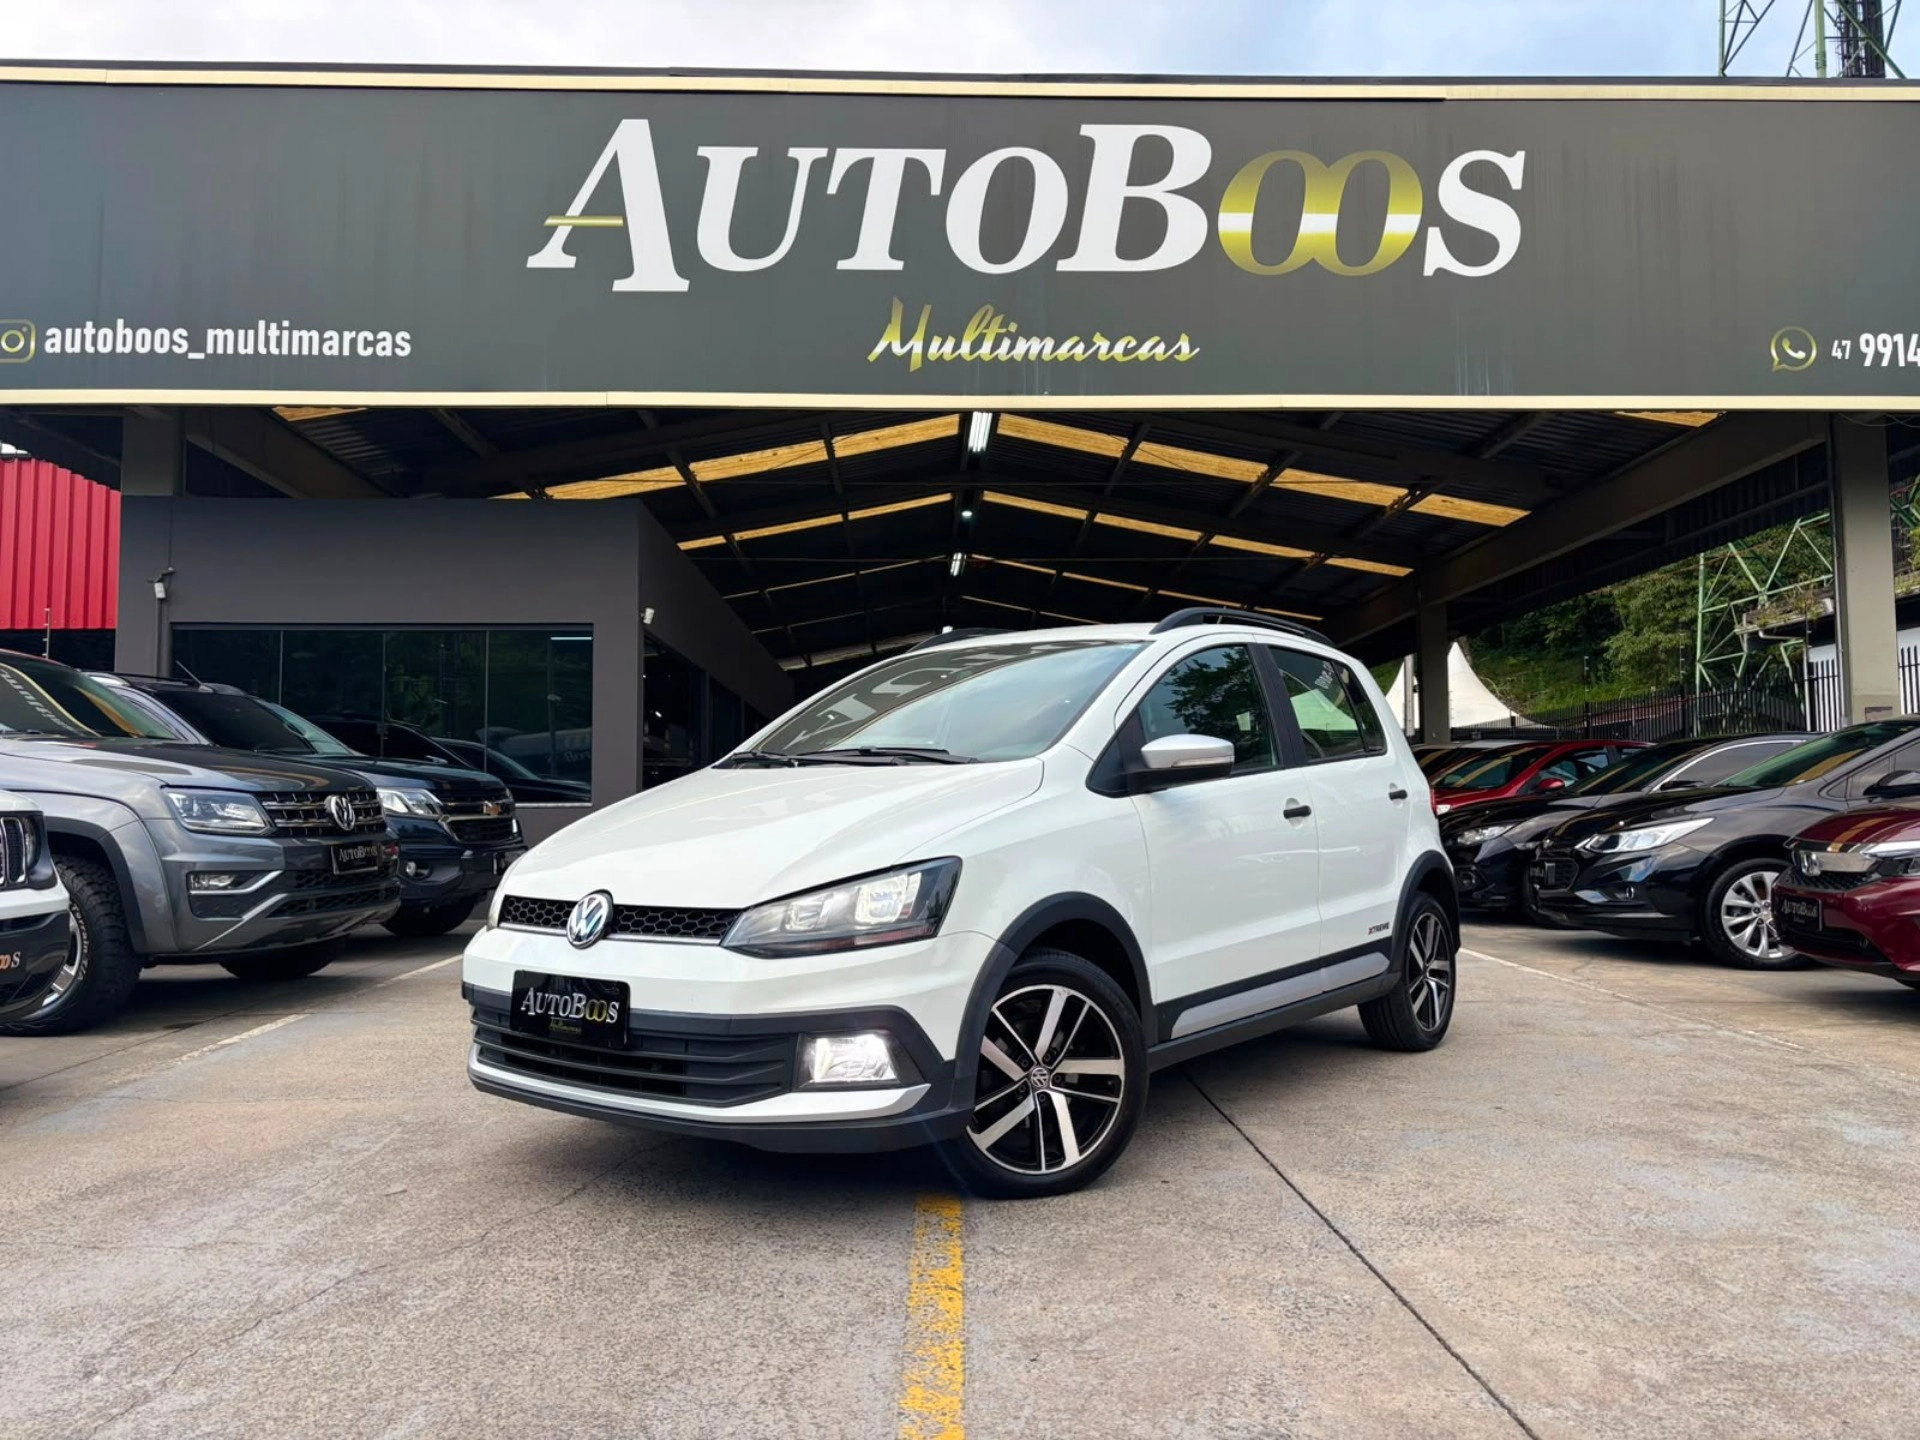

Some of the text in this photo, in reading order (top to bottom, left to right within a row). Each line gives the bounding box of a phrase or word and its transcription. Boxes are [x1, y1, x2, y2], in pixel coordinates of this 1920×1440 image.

[44, 318, 412, 360] autoboos_multimarcas
[867, 296, 1200, 373] Multimarcas
[1831, 332, 1920, 367] 47 9914
